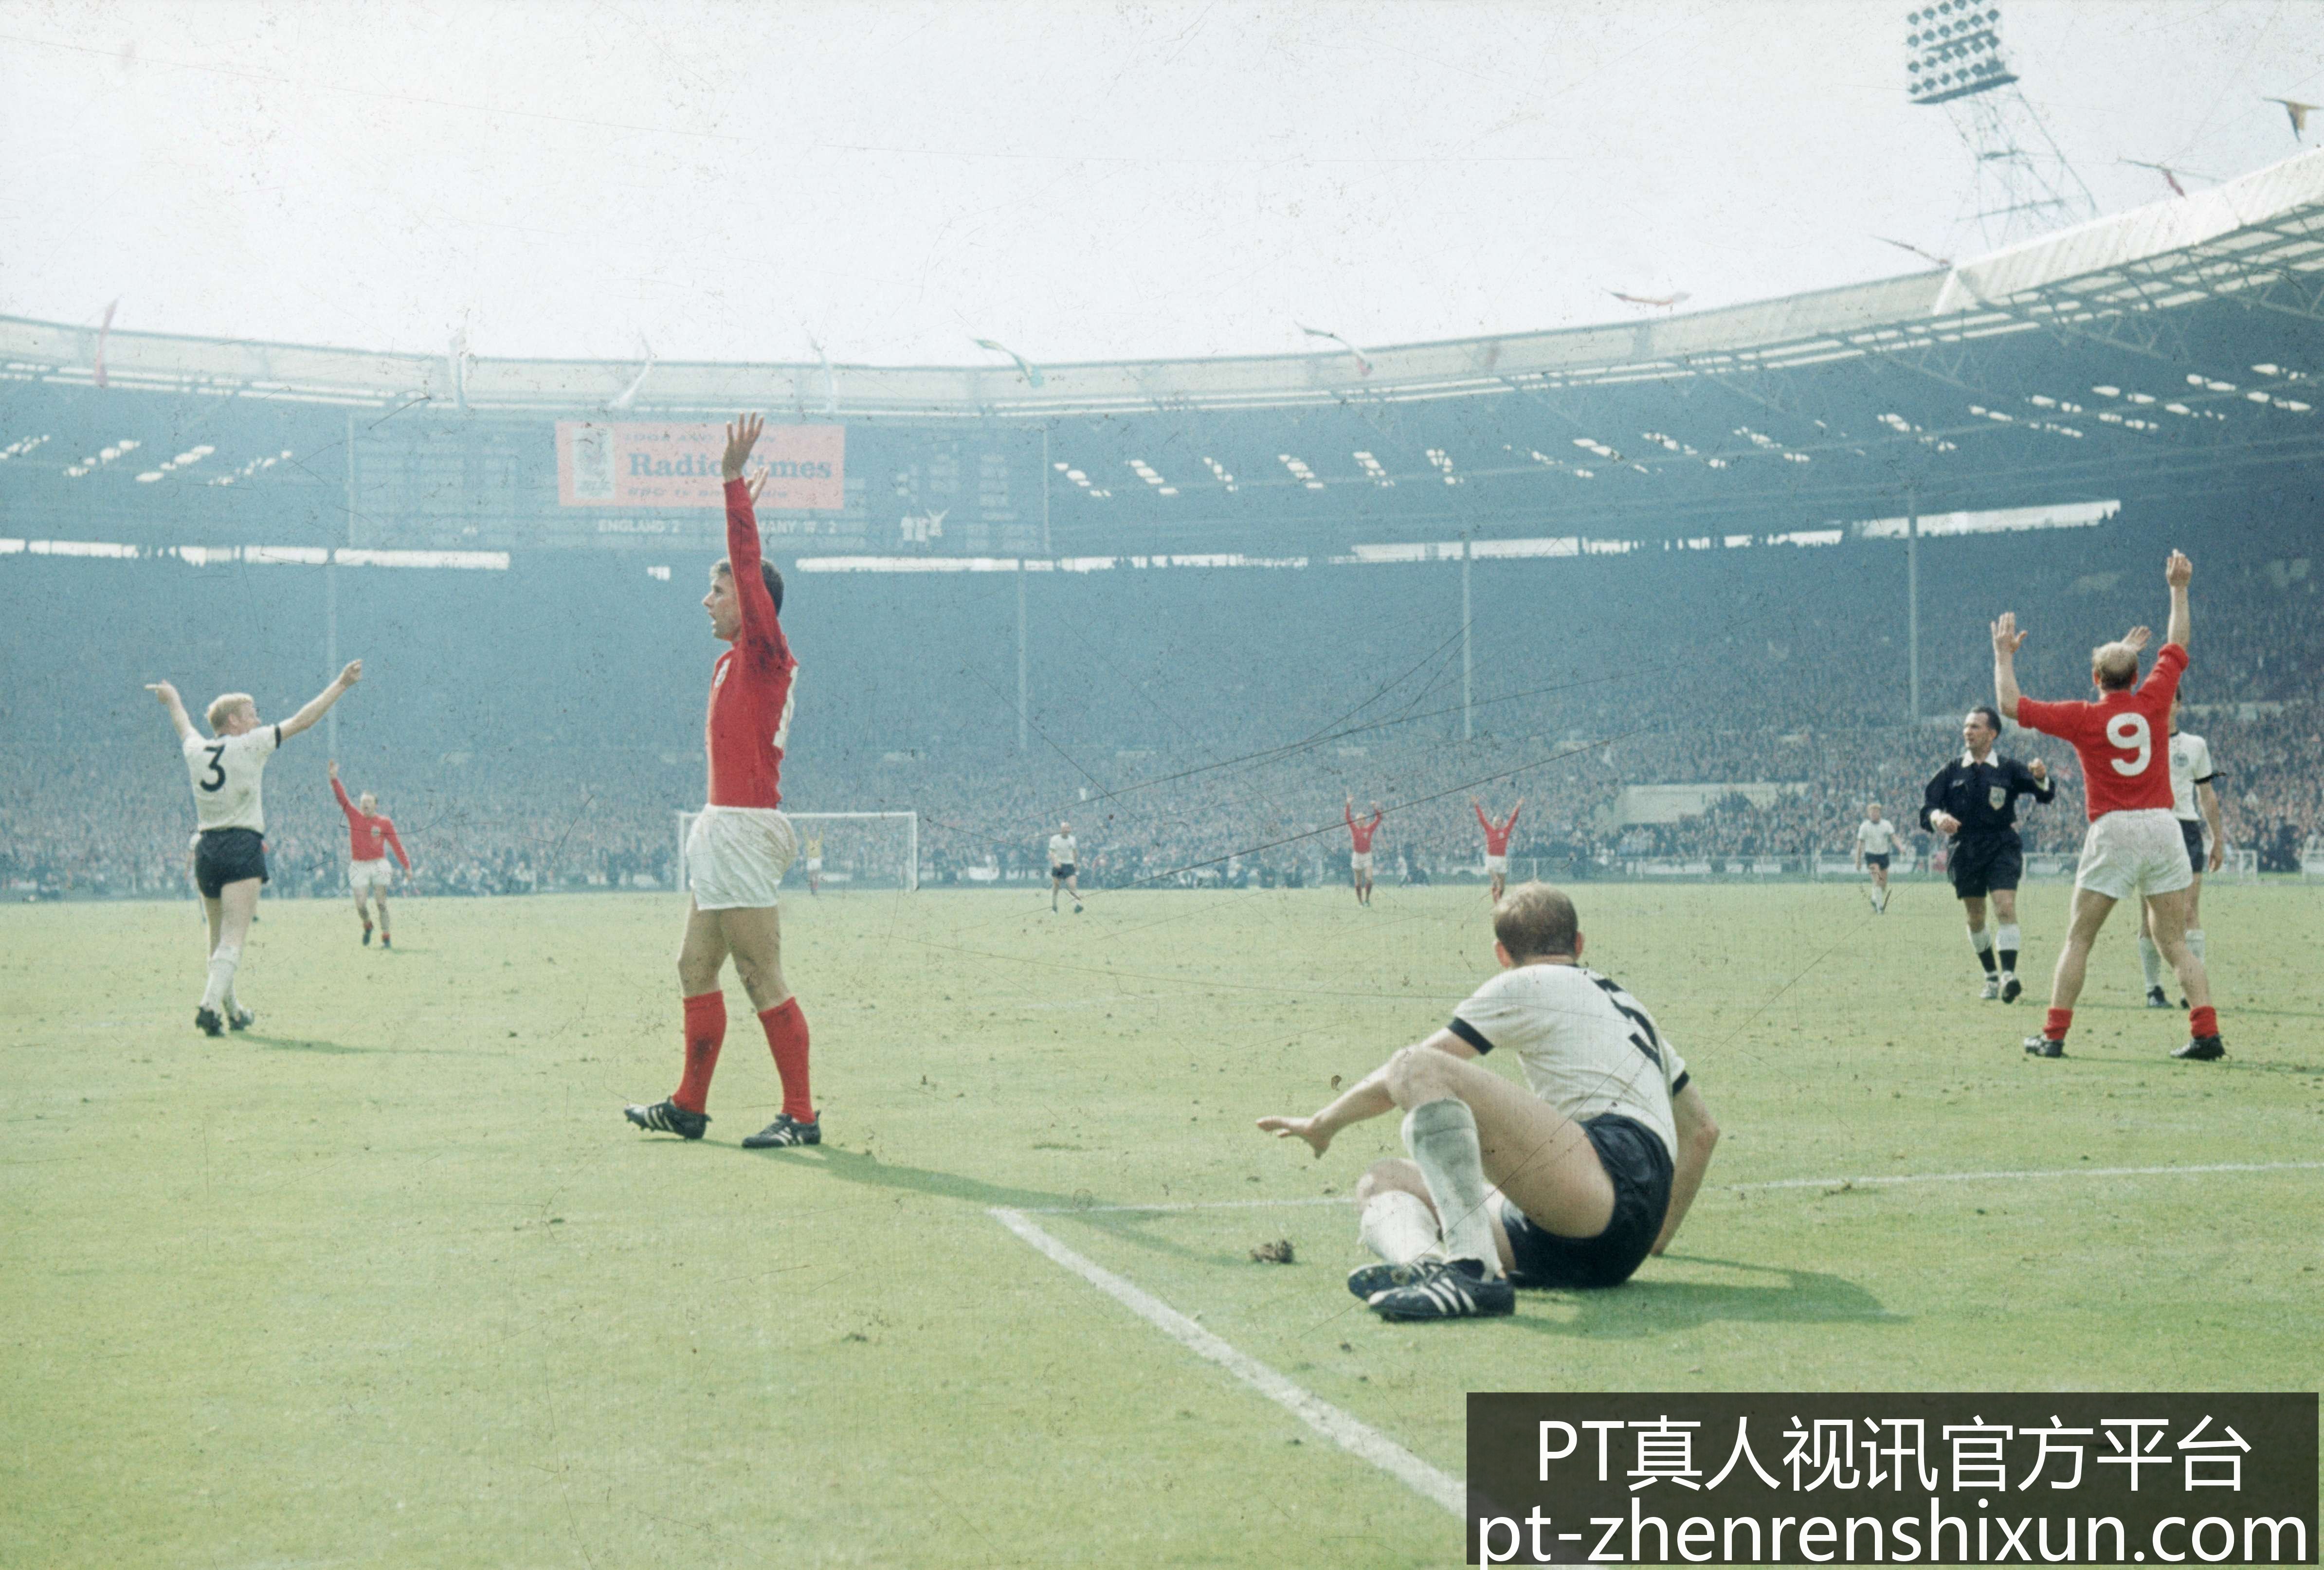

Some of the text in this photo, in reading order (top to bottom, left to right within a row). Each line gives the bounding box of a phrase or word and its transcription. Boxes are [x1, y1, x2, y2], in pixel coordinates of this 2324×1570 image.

[628, 453, 724, 477] Radio
[599, 519, 665, 533] ENGLAND
[758, 520, 797, 534] MANY
[828, 520, 838, 534] 2
[2106, 712, 2151, 776] 9
[200, 744, 226, 792] 3
